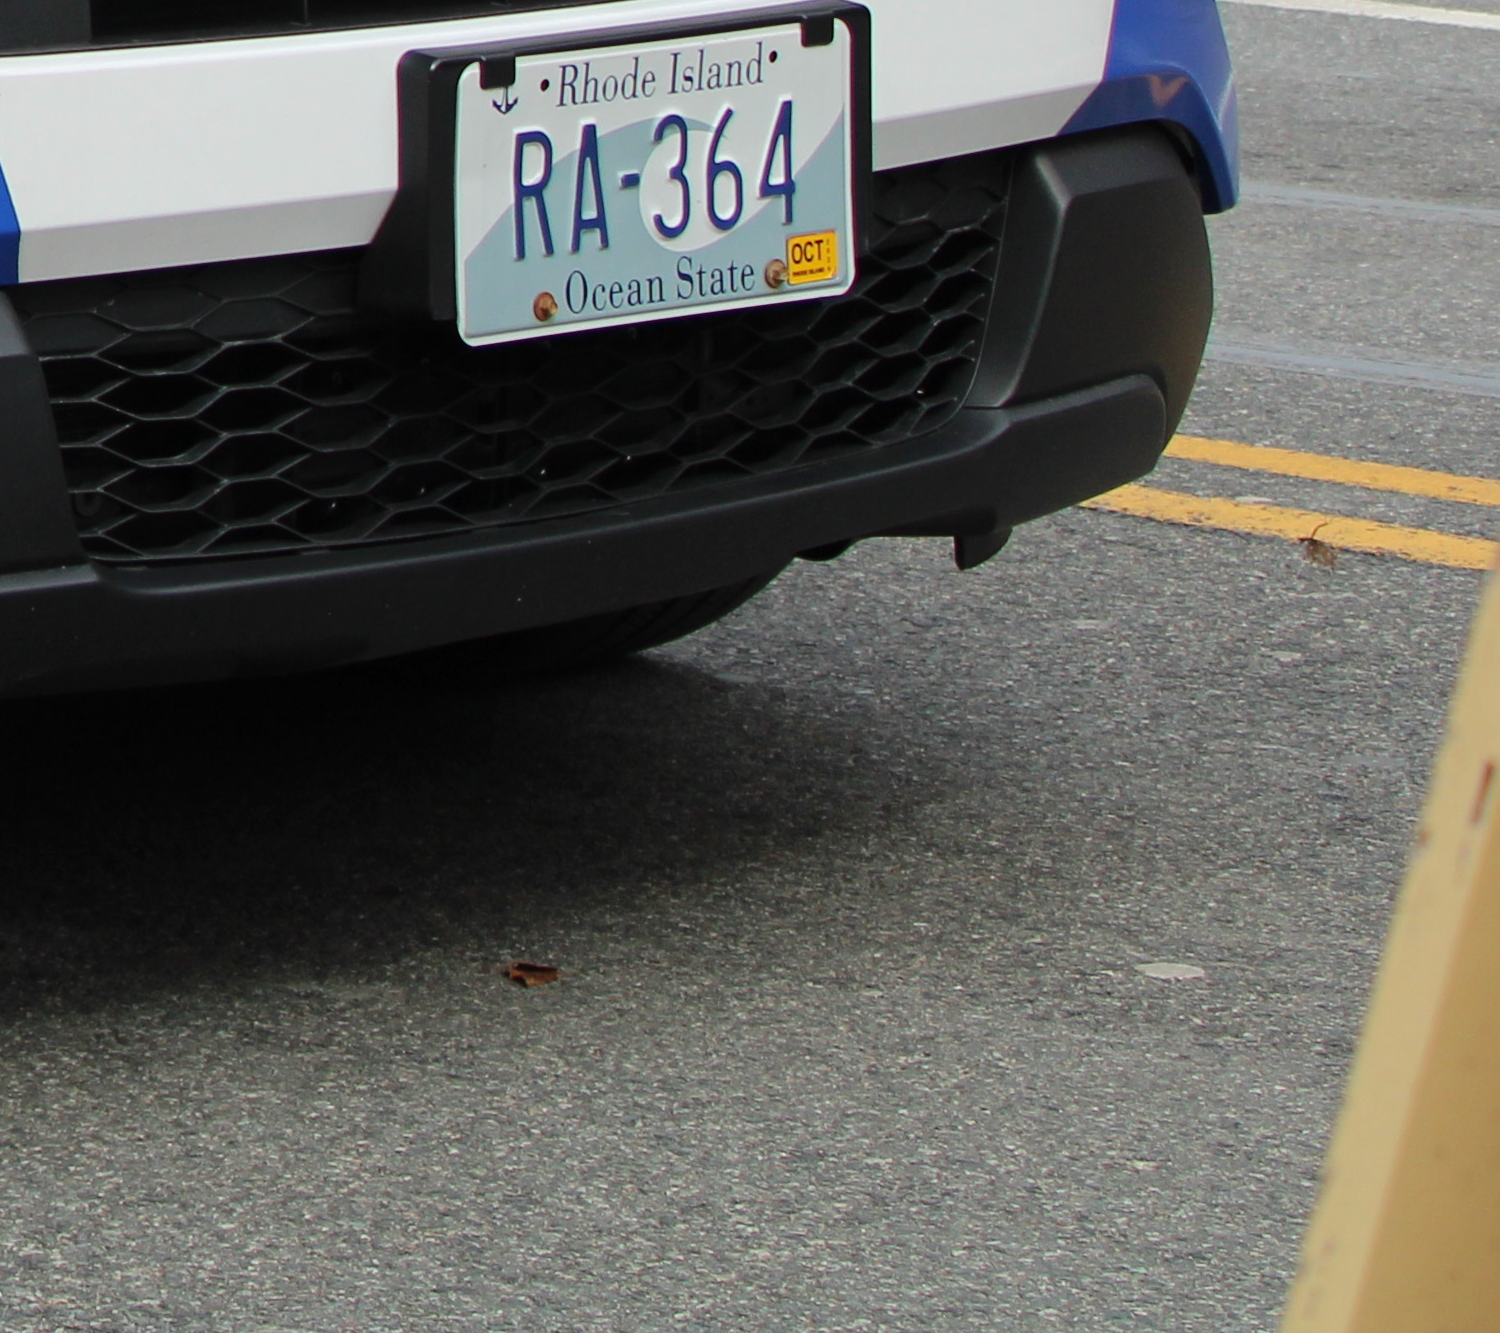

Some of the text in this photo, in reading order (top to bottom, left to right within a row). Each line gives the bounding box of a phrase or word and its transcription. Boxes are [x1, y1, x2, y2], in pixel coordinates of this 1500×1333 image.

[555, 41, 765, 108] Rhode Island
[512, 96, 797, 262] RA-364
[791, 239, 824, 265] OCT
[564, 255, 756, 315] Ocean State
